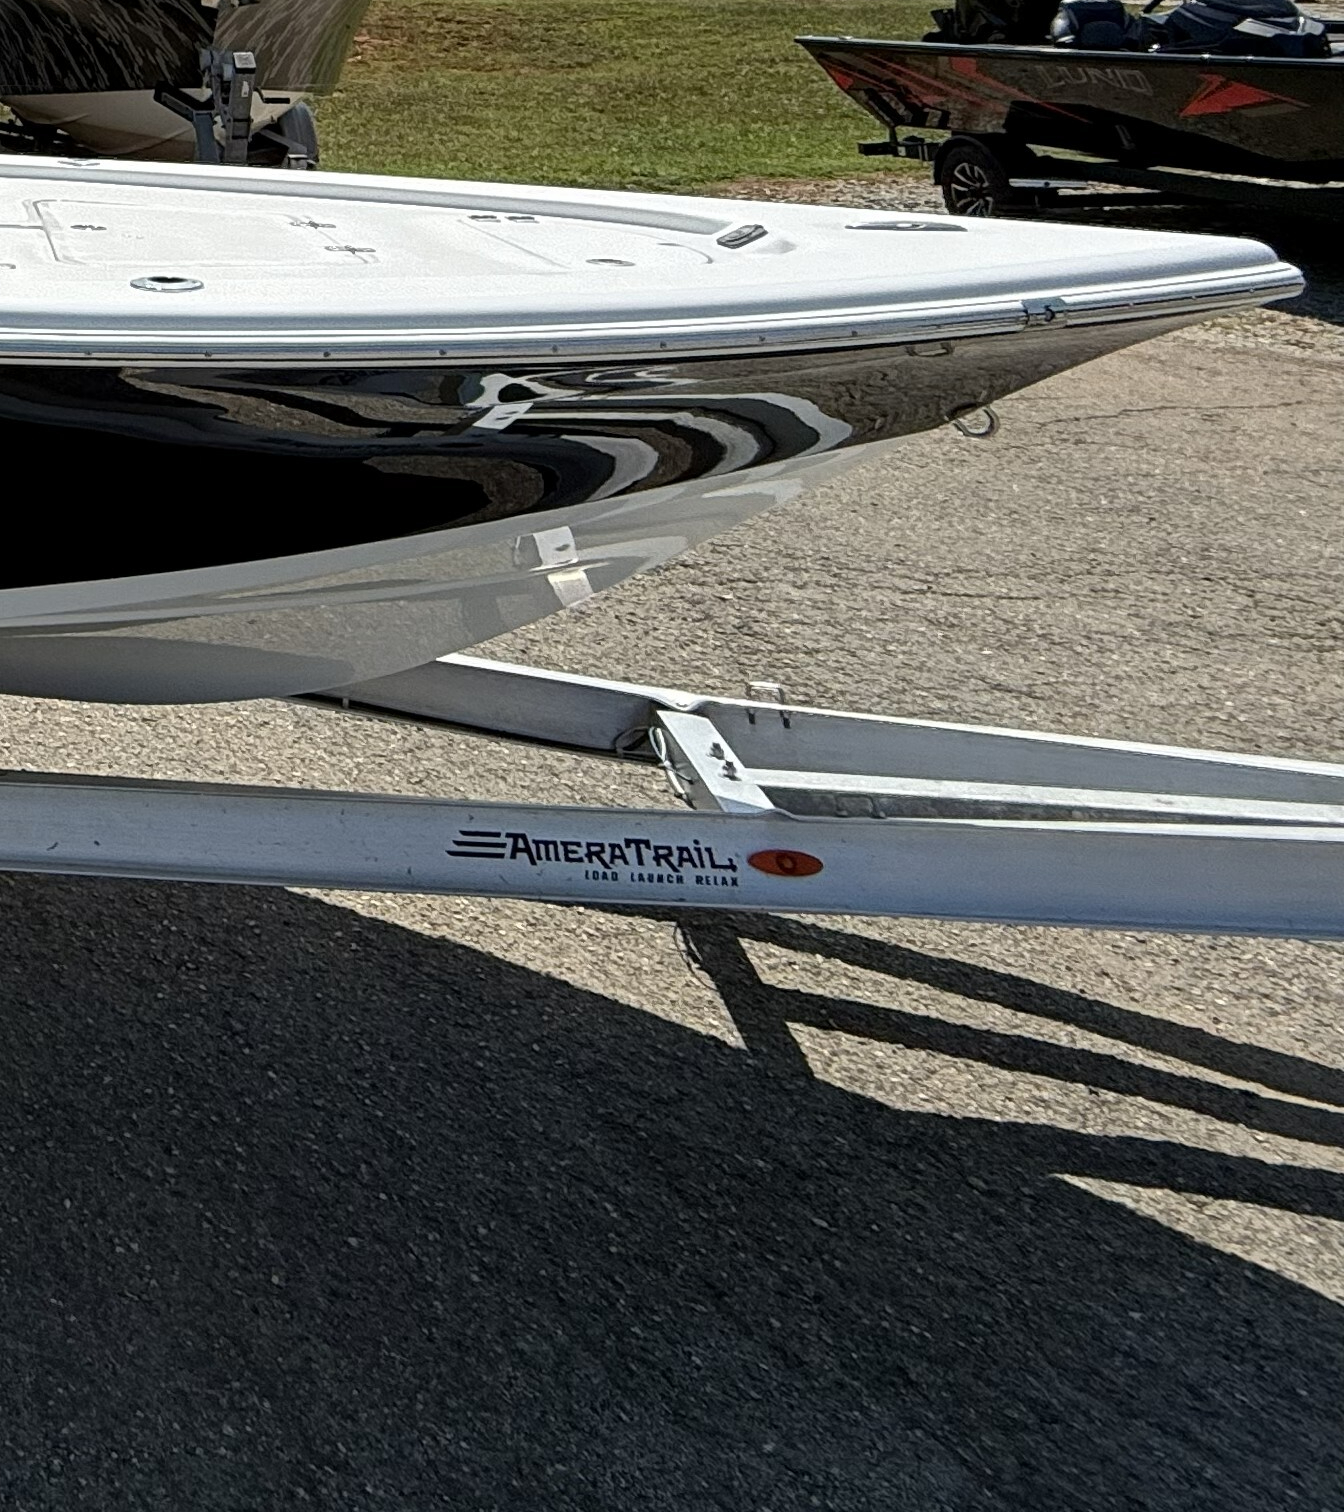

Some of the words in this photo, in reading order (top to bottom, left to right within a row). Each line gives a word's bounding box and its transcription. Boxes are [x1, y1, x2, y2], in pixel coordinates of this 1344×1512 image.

[1035, 65, 1154, 96] LUND
[584, 870, 619, 882] LOAD
[630, 872, 685, 885] LAUNCH
[695, 875, 739, 887] RELAX
